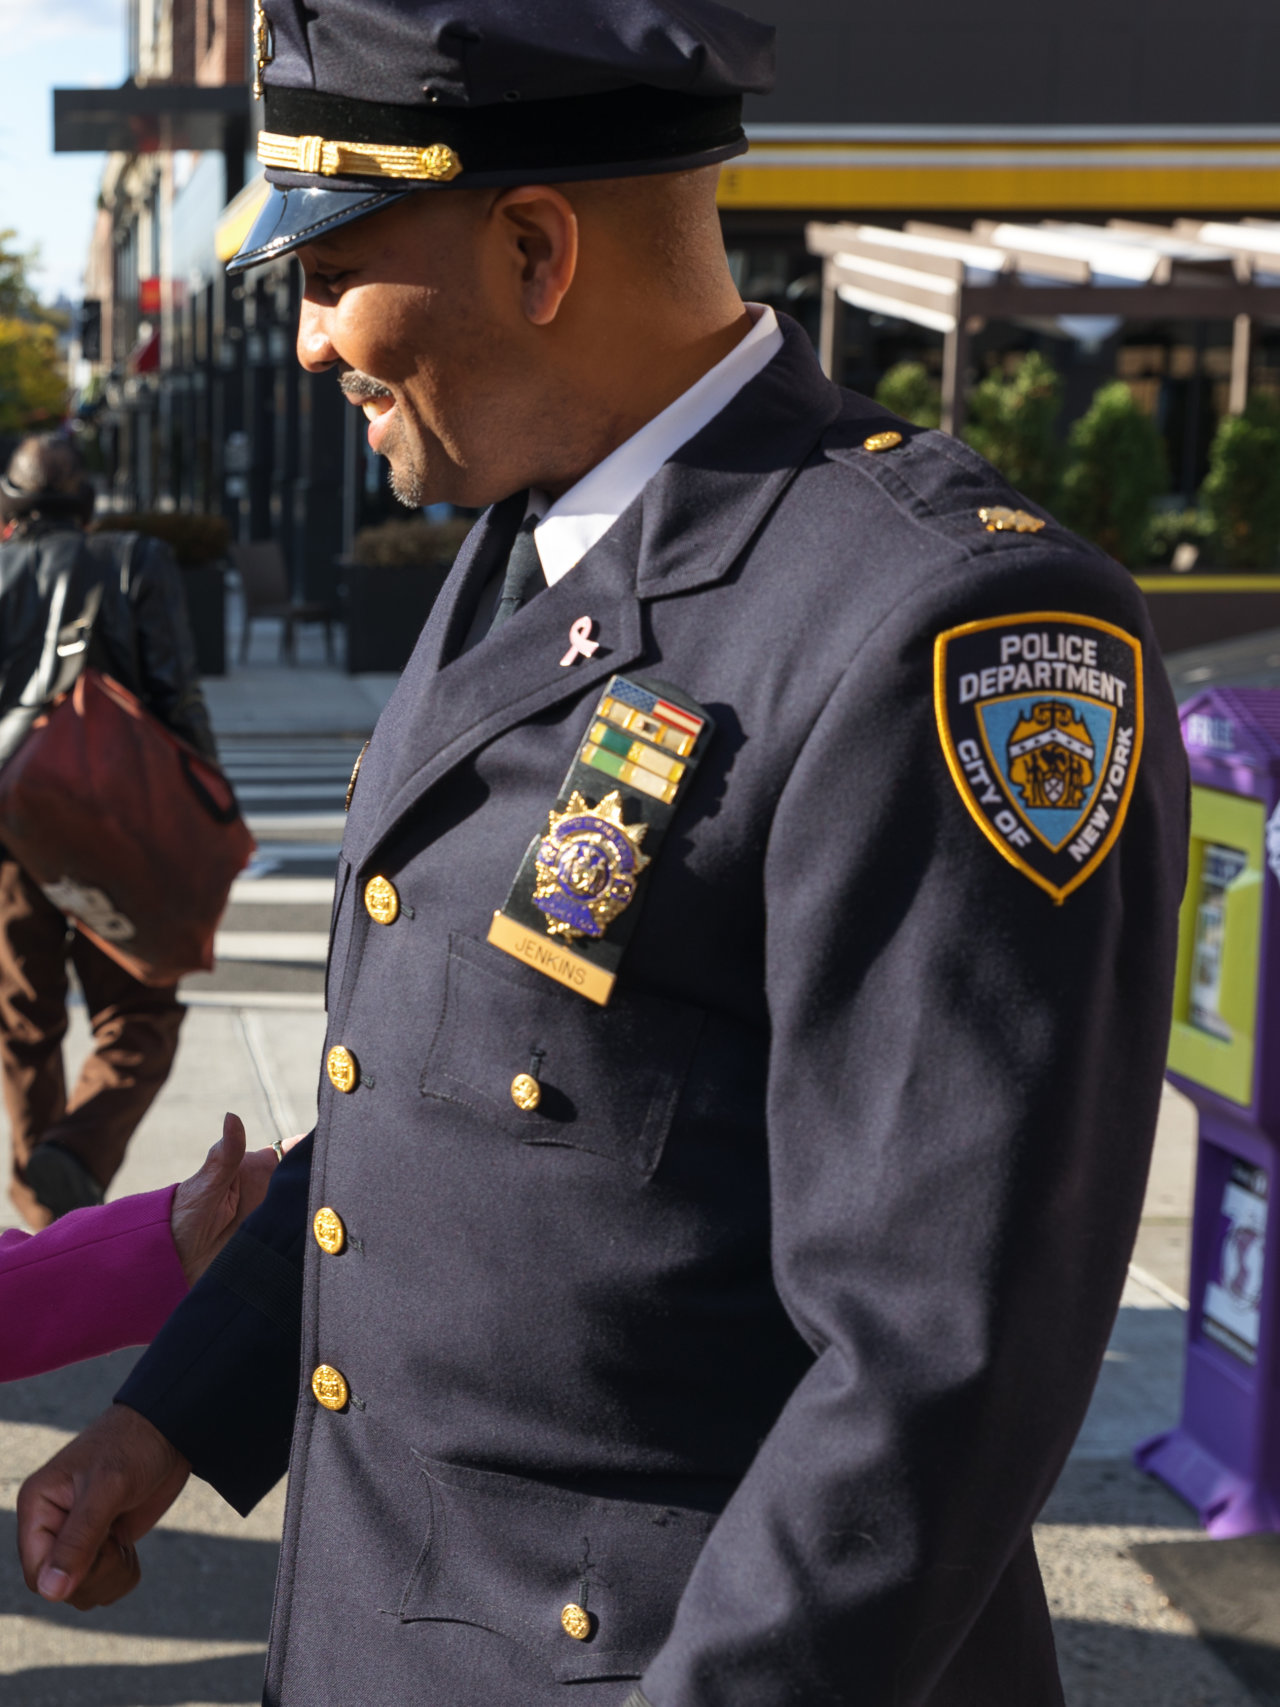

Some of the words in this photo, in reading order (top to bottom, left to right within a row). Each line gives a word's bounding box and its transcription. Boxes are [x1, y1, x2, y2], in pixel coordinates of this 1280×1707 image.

[1000, 632, 1098, 666] POLICE
[958, 661, 1128, 708] DEPARTMENT
[957, 739, 1003, 805] CITY
[993, 808, 1032, 849] OF
[1067, 804, 1111, 863] NEW
[1101, 726, 1134, 803] YORK
[514, 937, 587, 986] JENKINS
